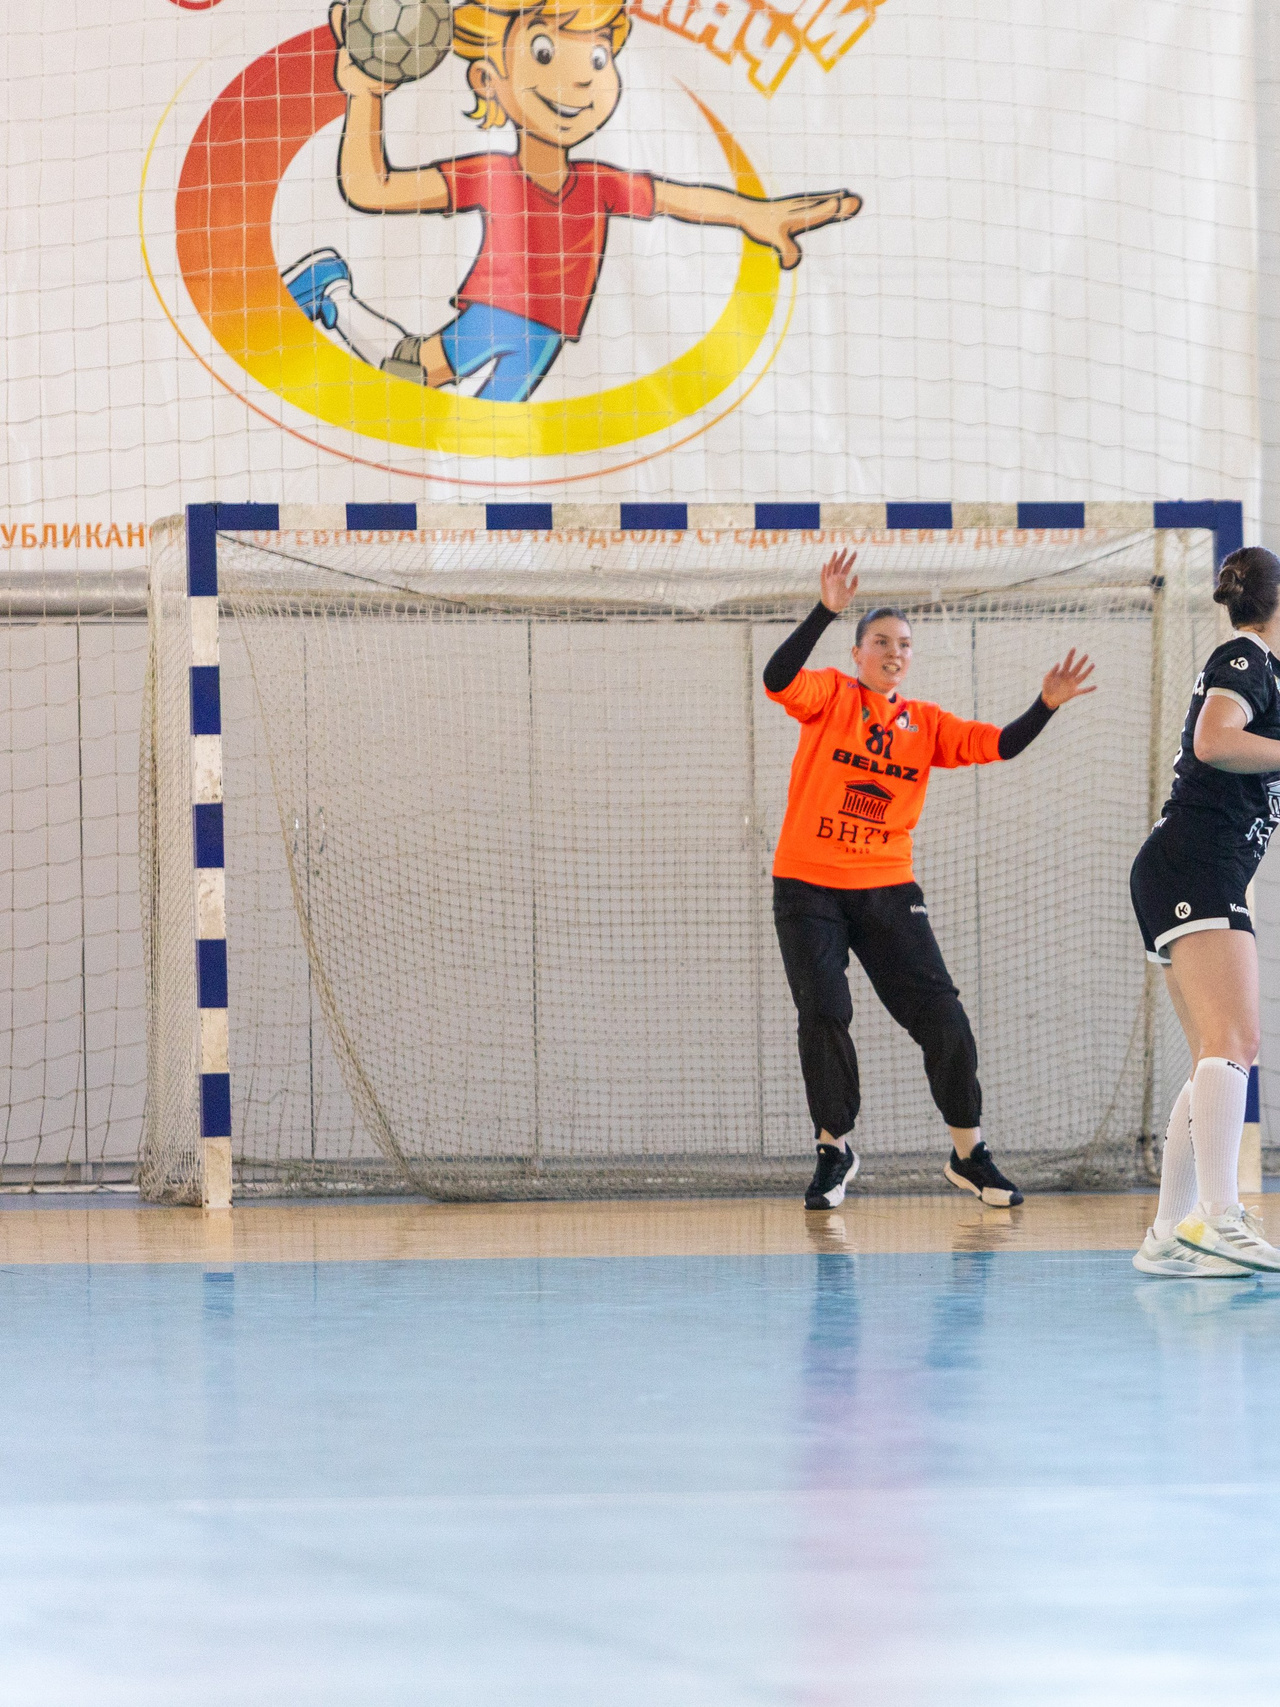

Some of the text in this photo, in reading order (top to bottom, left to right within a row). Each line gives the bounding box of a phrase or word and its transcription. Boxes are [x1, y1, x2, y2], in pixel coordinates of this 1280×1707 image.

[0, 522, 152, 549] УБЛИКАН
[832, 748, 919, 783] BELAZ
[1230, 903, 1250, 917] Kemp
